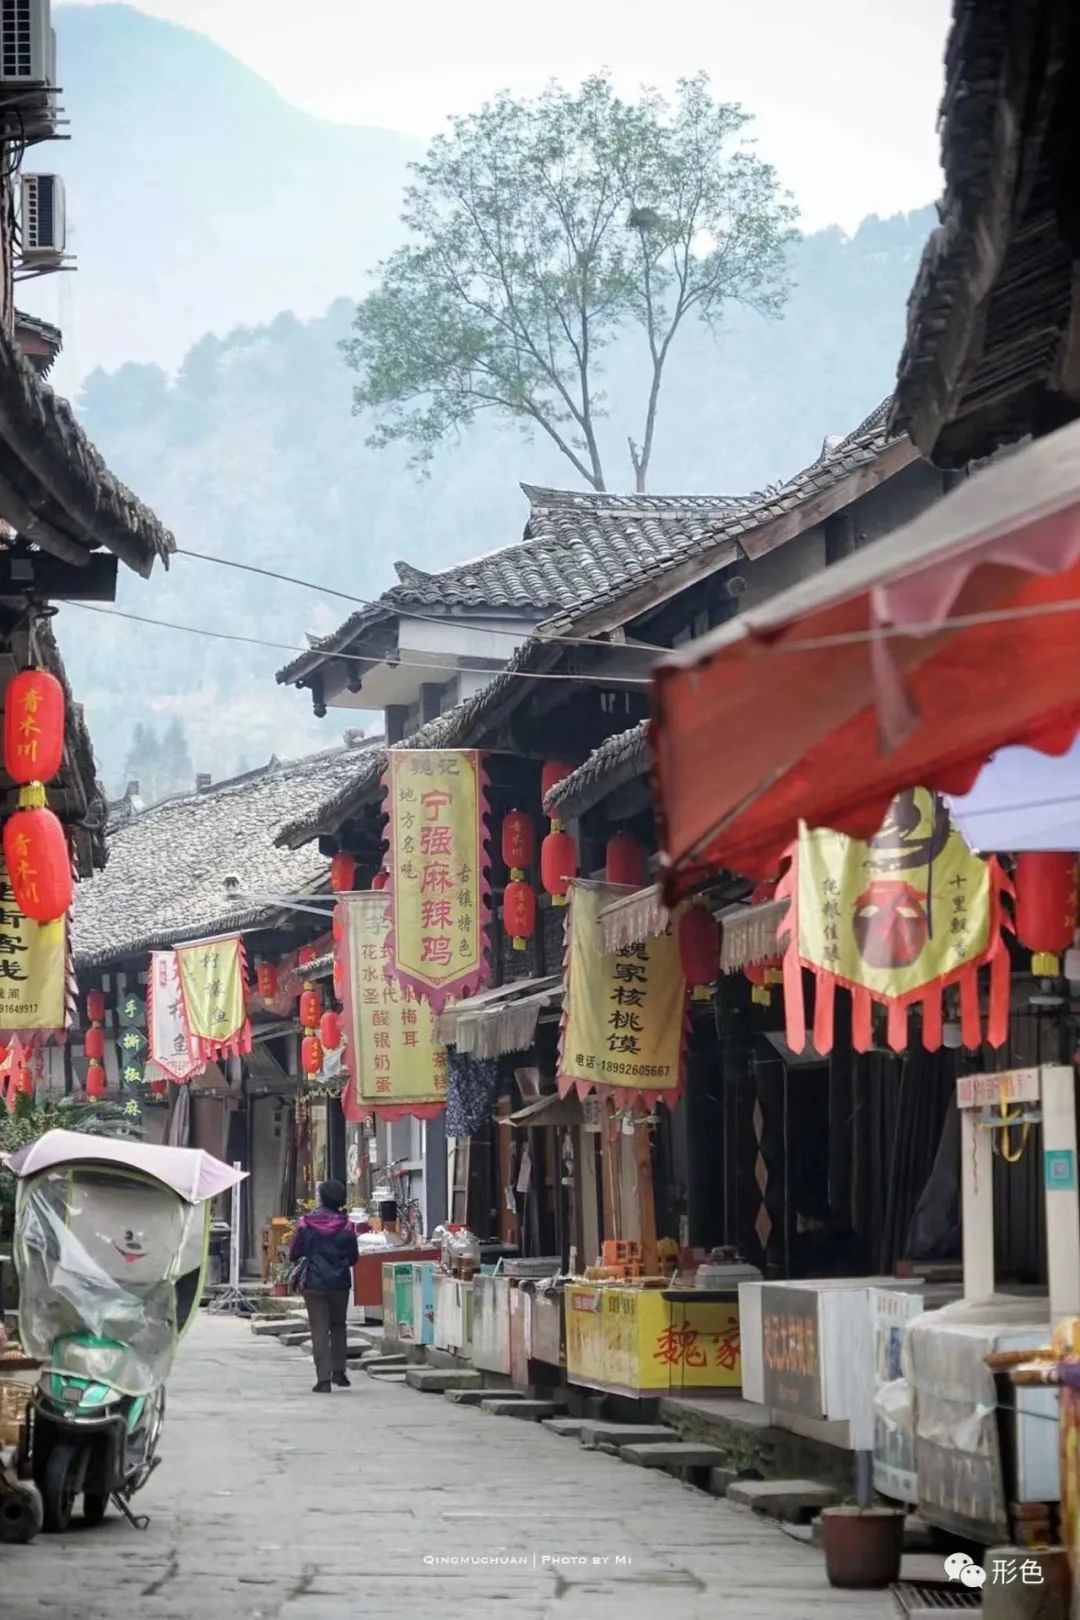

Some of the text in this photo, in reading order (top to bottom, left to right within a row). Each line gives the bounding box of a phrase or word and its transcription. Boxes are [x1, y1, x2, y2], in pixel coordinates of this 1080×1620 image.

[17, 688, 43, 762] 青木川
[13, 832, 40, 903] 青木川
[420, 788, 454, 966] 宁强麻辣鸡
[456, 863, 473, 958] 古镇特色
[653, 1317, 740, 1371] 魏家
